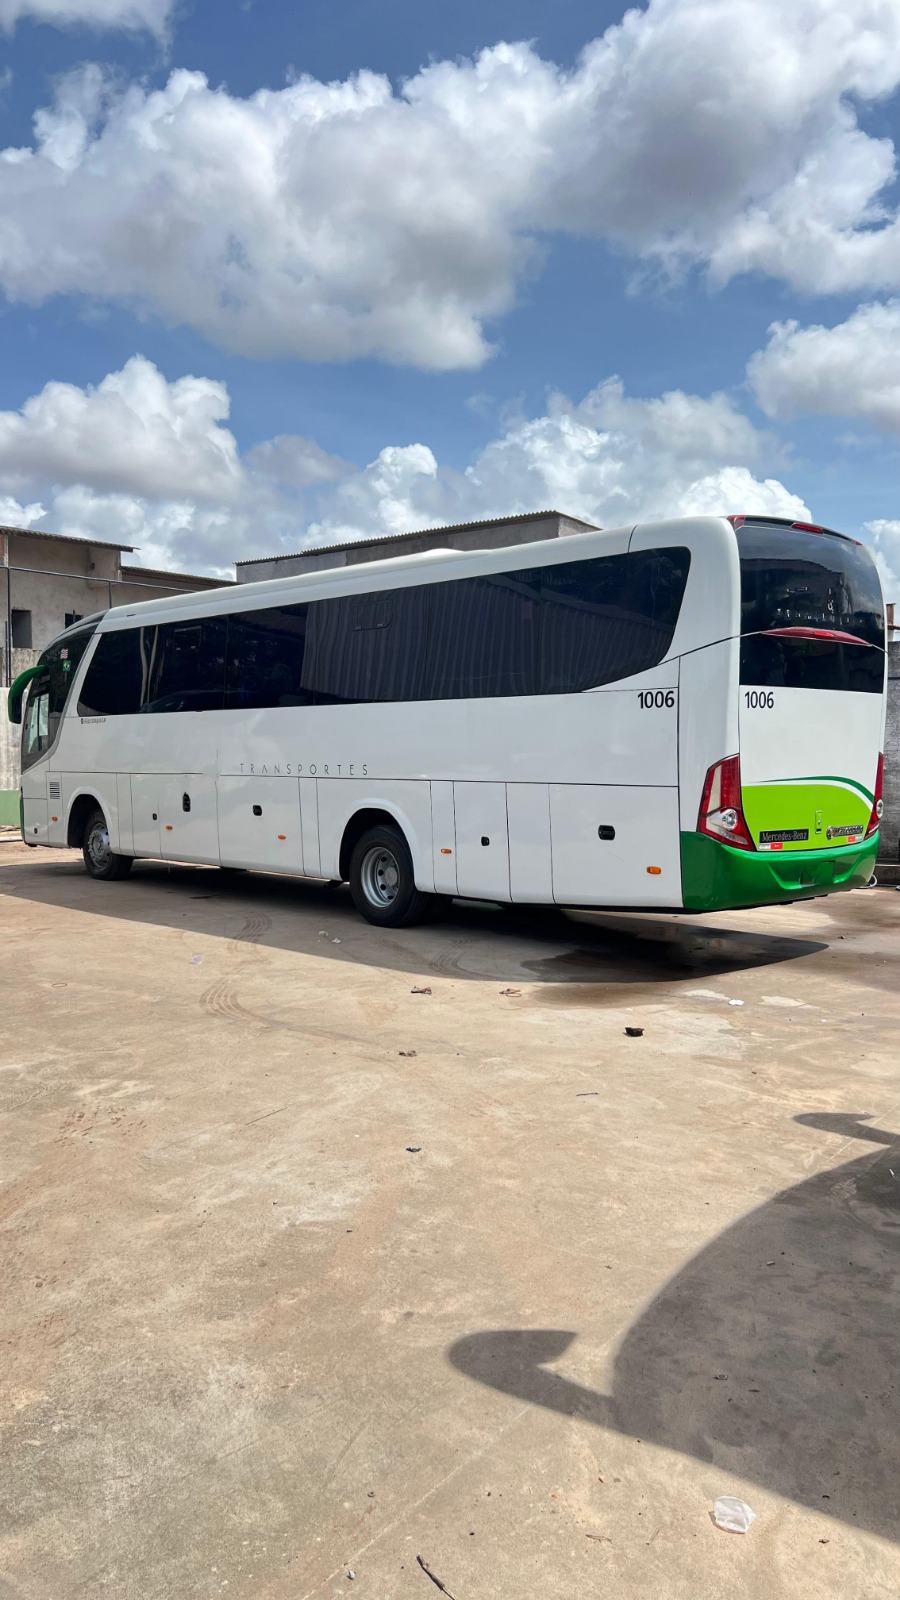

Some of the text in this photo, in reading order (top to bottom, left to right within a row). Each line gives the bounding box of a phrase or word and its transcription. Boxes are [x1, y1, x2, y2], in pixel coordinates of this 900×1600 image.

[637, 690, 675, 709] 1006
[744, 691, 774, 709] 1006
[240, 763, 368, 776] TRANSPORTES
[762, 831, 807, 842] Mercedes-Benz
